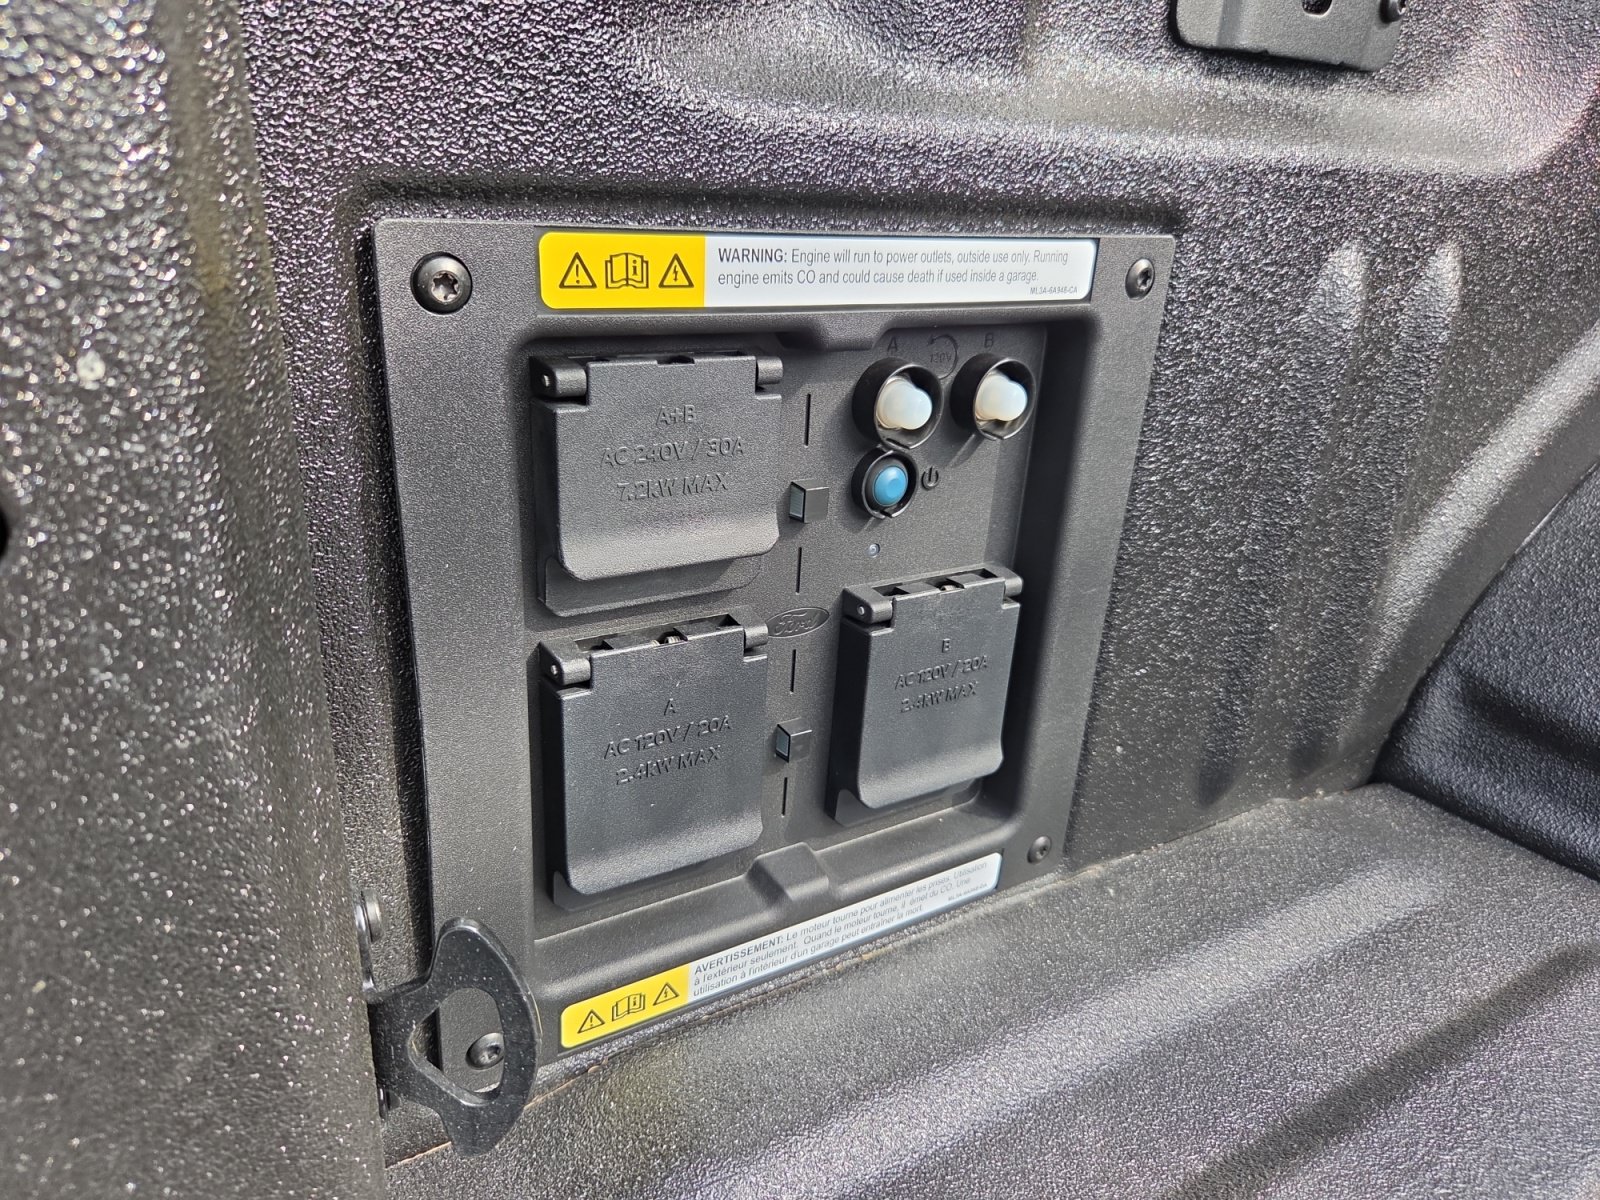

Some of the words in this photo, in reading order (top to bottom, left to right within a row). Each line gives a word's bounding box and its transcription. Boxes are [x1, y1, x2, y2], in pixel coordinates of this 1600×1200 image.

[718, 248, 787, 263] WARNING:
[791, 249, 830, 266] Engine
[833, 249, 850, 263] will
[853, 252, 870, 263] run
[873, 250, 883, 263] to
[886, 252, 917, 266] power
[920, 250, 954, 264] outlets,
[957, 250, 990, 263] outside
[992, 252, 1008, 263] use
[1011, 250, 1031, 266] only.
[1033, 250, 1068, 266] Running
[718, 271, 759, 288] engine
[763, 271, 793, 284] emits
[797, 270, 815, 284] CO
[819, 270, 839, 283] and
[842, 270, 870, 283] could
[873, 271, 904, 283] cause
[907, 270, 934, 283] death
[937, 270, 944, 282] if
[945, 270, 967, 282] used
[970, 270, 996, 282] inside
[999, 272, 1004, 281] a
[1007, 271, 1039, 284] garage.
[887, 336, 898, 352] A
[984, 332, 994, 348] B
[656, 404, 696, 425] A+B
[600, 446, 630, 468] AC
[634, 440, 689, 464] 240V
[706, 436, 744, 457] 30A
[682, 471, 730, 495] MAX
[895, 672, 914, 690] AC
[917, 662, 952, 684] 120V
[962, 655, 988, 673] 20A
[945, 681, 980, 702] MAX
[663, 698, 676, 716] A
[604, 737, 630, 759] AC
[634, 725, 681, 751] 120V
[698, 715, 732, 736] 20A
[677, 745, 722, 770] MAX
[694, 936, 784, 975] AVERTISSEMENT:
[786, 932, 798, 941] Le
[800, 920, 831, 936] moteur
[833, 909, 859, 924] tourne
[860, 903, 879, 915] pour
[880, 889, 914, 907] alimenter
[916, 885, 927, 894] les
[694, 977, 700, 986] à
[703, 960, 747, 982] l'extérieur
[750, 943, 797, 965] seulement.
[803, 930, 832, 945] Quand
[834, 926, 841, 934] le
[844, 915, 871, 931] moteur
[929, 890, 939, 898] du
[693, 974, 738, 997] utilisation
[740, 970, 746, 979] à
[749, 955, 789, 975] l'intérieur
[790, 948, 808, 960] d'un
[811, 938, 839, 955] garage
[841, 929, 860, 942] peut
[905, 905, 923, 917] mort
